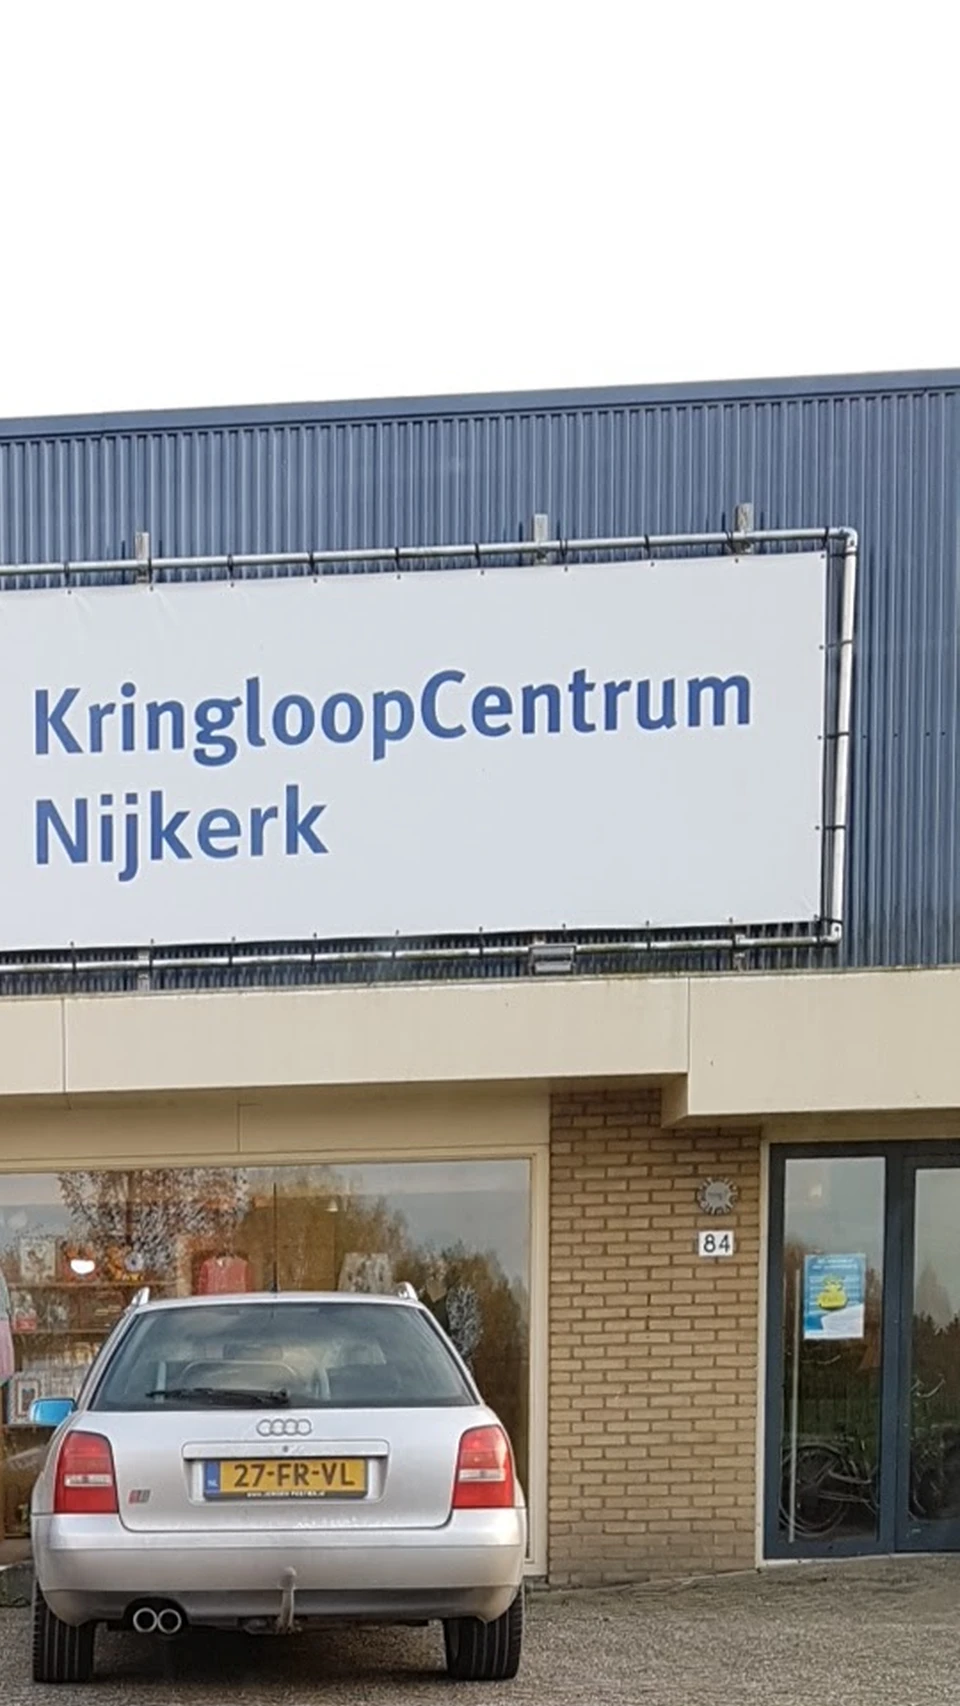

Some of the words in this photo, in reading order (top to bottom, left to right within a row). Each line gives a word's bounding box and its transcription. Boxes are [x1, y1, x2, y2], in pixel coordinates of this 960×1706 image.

[34, 668, 750, 767] KringloopCentrum
[35, 784, 330, 882] Nijkerk
[703, 1233, 730, 1253] 84
[234, 1462, 355, 1487] 27-FR-VL
